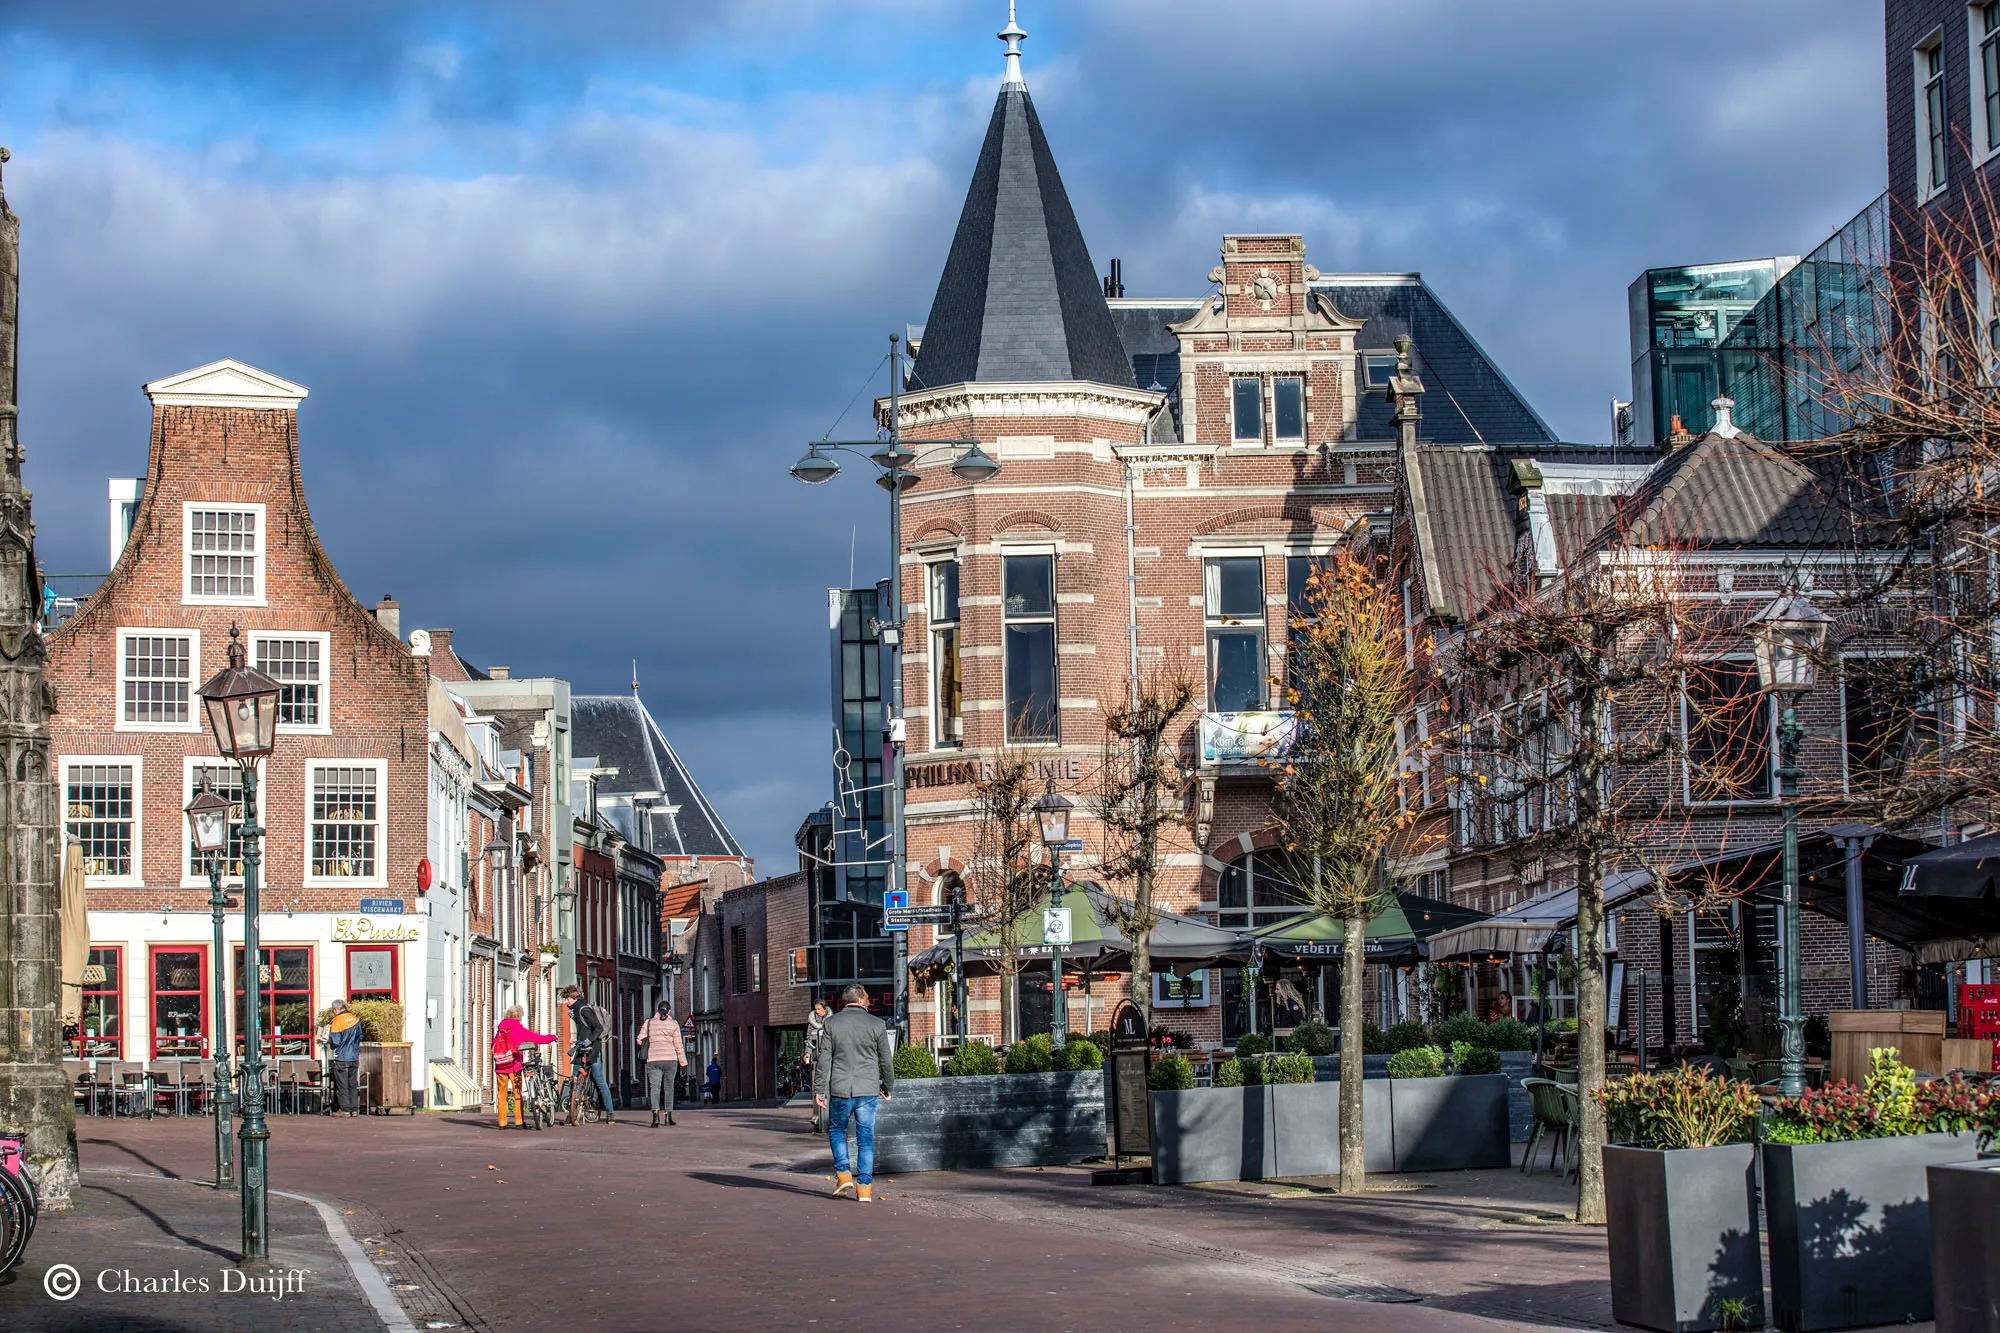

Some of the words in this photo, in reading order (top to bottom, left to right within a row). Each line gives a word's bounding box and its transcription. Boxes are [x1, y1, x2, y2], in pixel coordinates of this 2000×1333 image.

[1214, 737, 1236, 746] Komt
[1213, 746, 1252, 754] tezamen
[334, 917, 352, 940] El
[351, 917, 419, 940] Pincho
[1294, 944, 1339, 954] VEDETT
